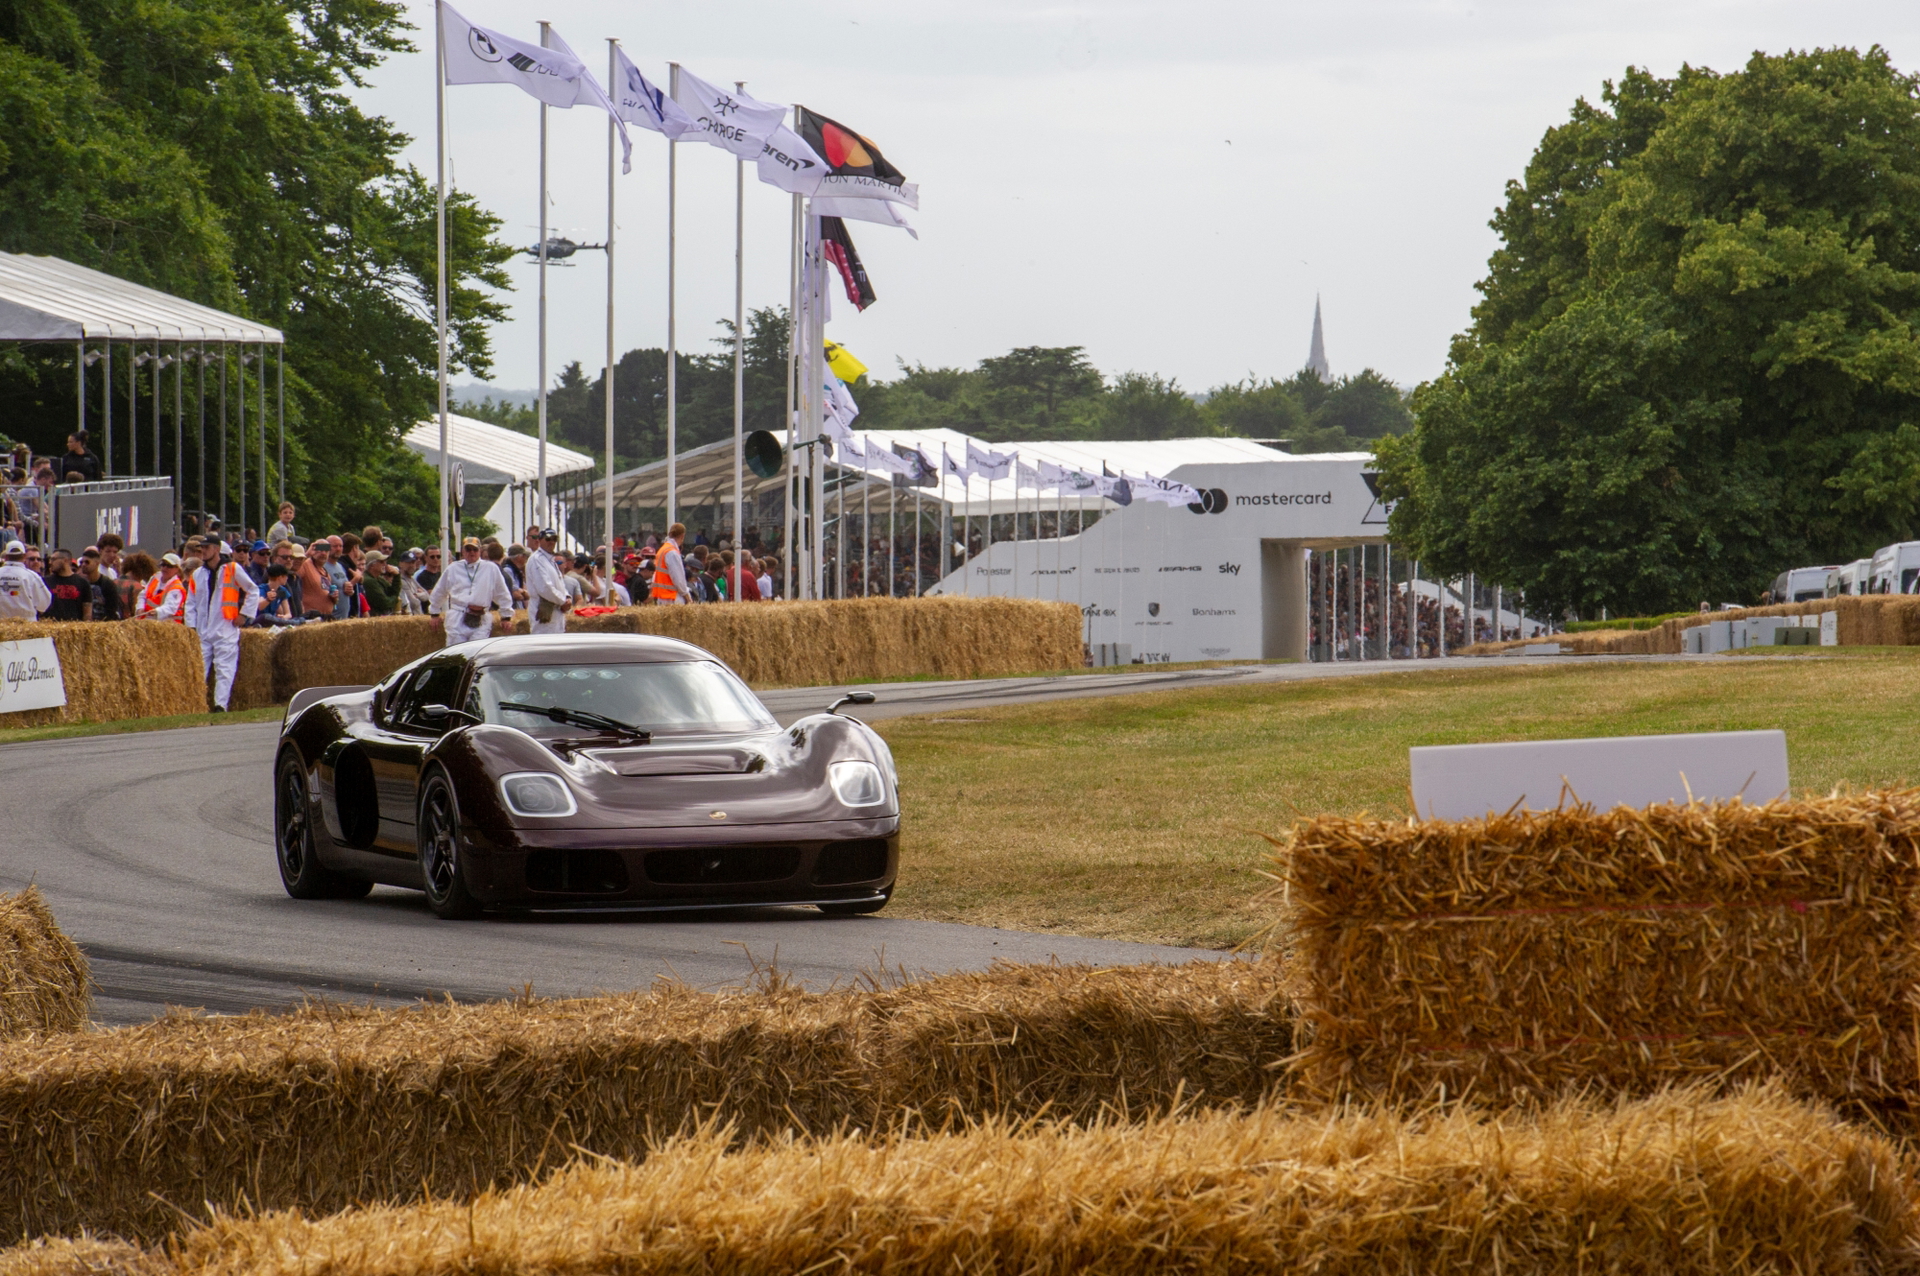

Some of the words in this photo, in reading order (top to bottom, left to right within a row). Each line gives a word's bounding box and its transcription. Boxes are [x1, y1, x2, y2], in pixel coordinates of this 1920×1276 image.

[1236, 491, 1332, 506] mastercard
[976, 567, 1012, 576] Poestar
[1218, 562, 1241, 576] sky
[1192, 608, 1236, 617] Bonhams
[7, 661, 28, 693] Alfa
[28, 656, 56, 681] Romeo
